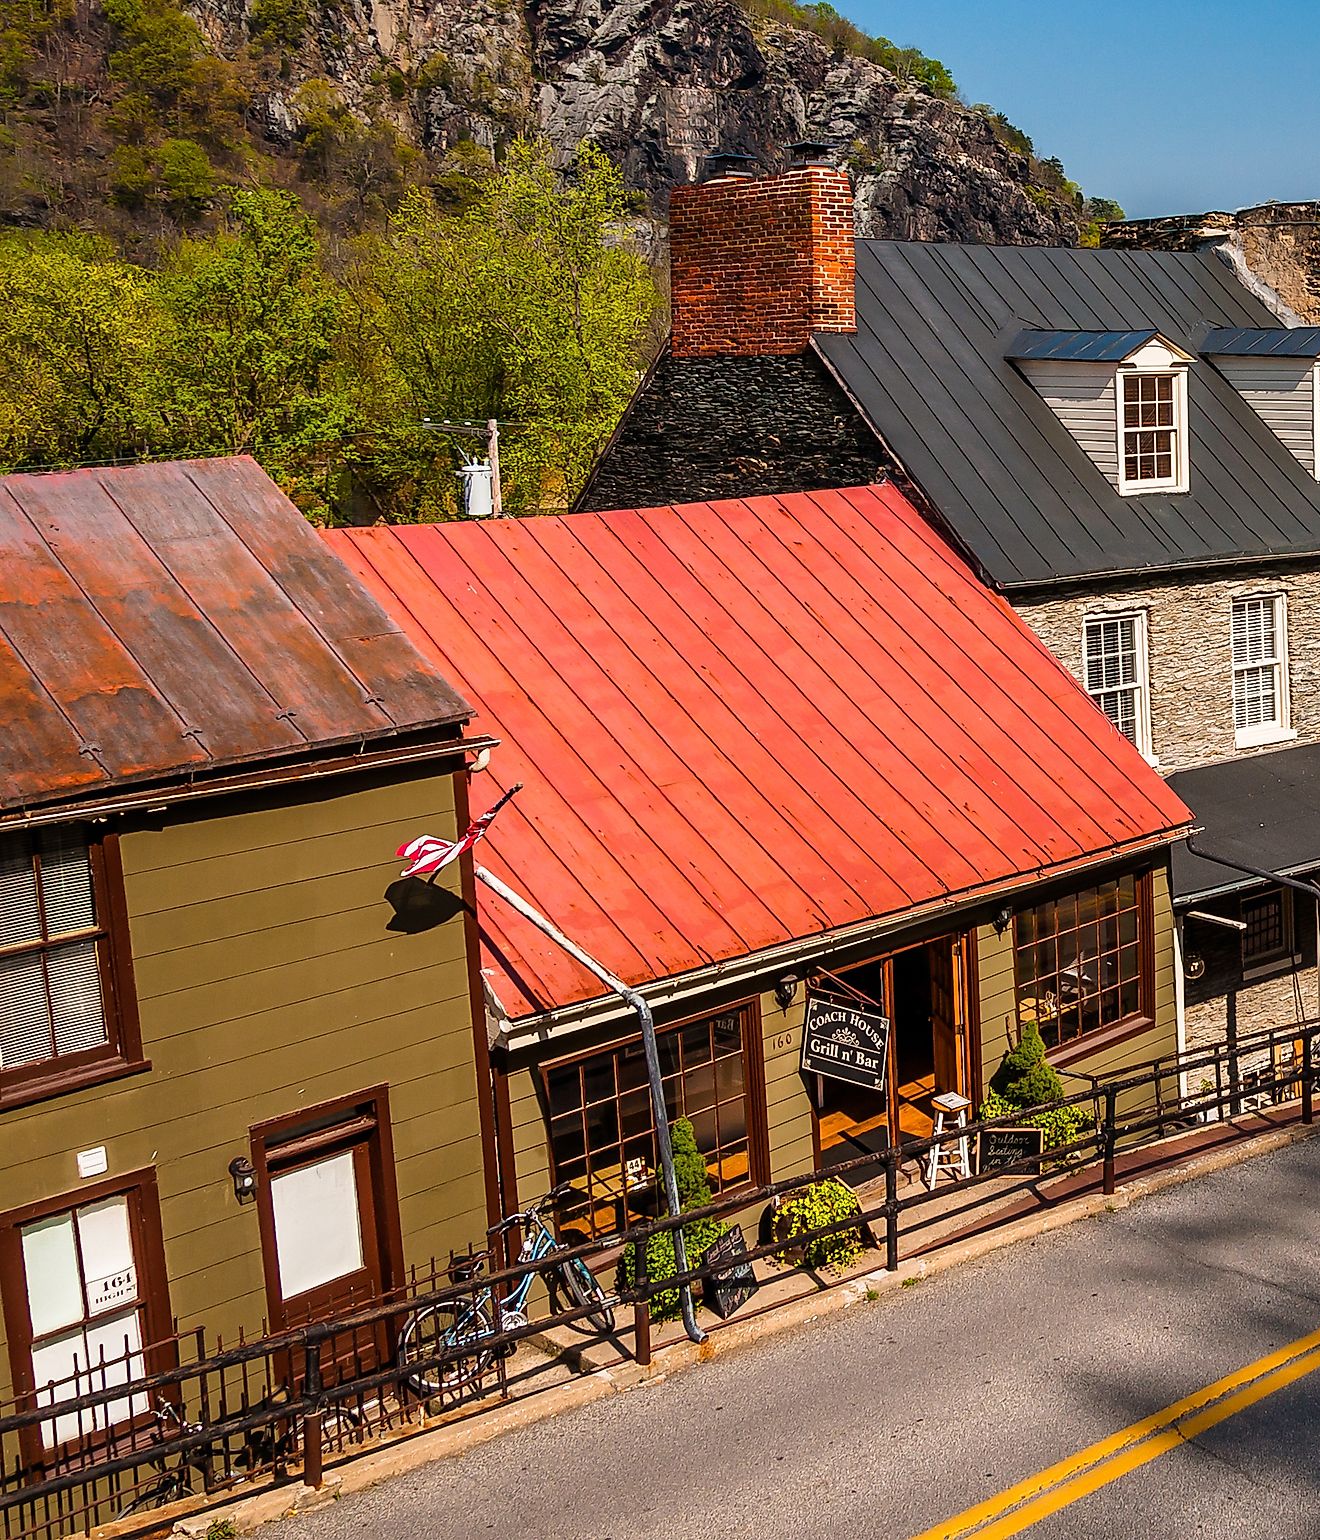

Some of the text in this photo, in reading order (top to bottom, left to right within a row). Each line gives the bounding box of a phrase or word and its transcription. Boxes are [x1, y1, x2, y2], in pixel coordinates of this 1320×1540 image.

[809, 1011, 885, 1050] COACH HOUSE
[772, 1033, 792, 1050] 160
[810, 1039, 879, 1069] Grill n' Bar
[629, 1160, 640, 1170] 44
[103, 1272, 132, 1292] 164
